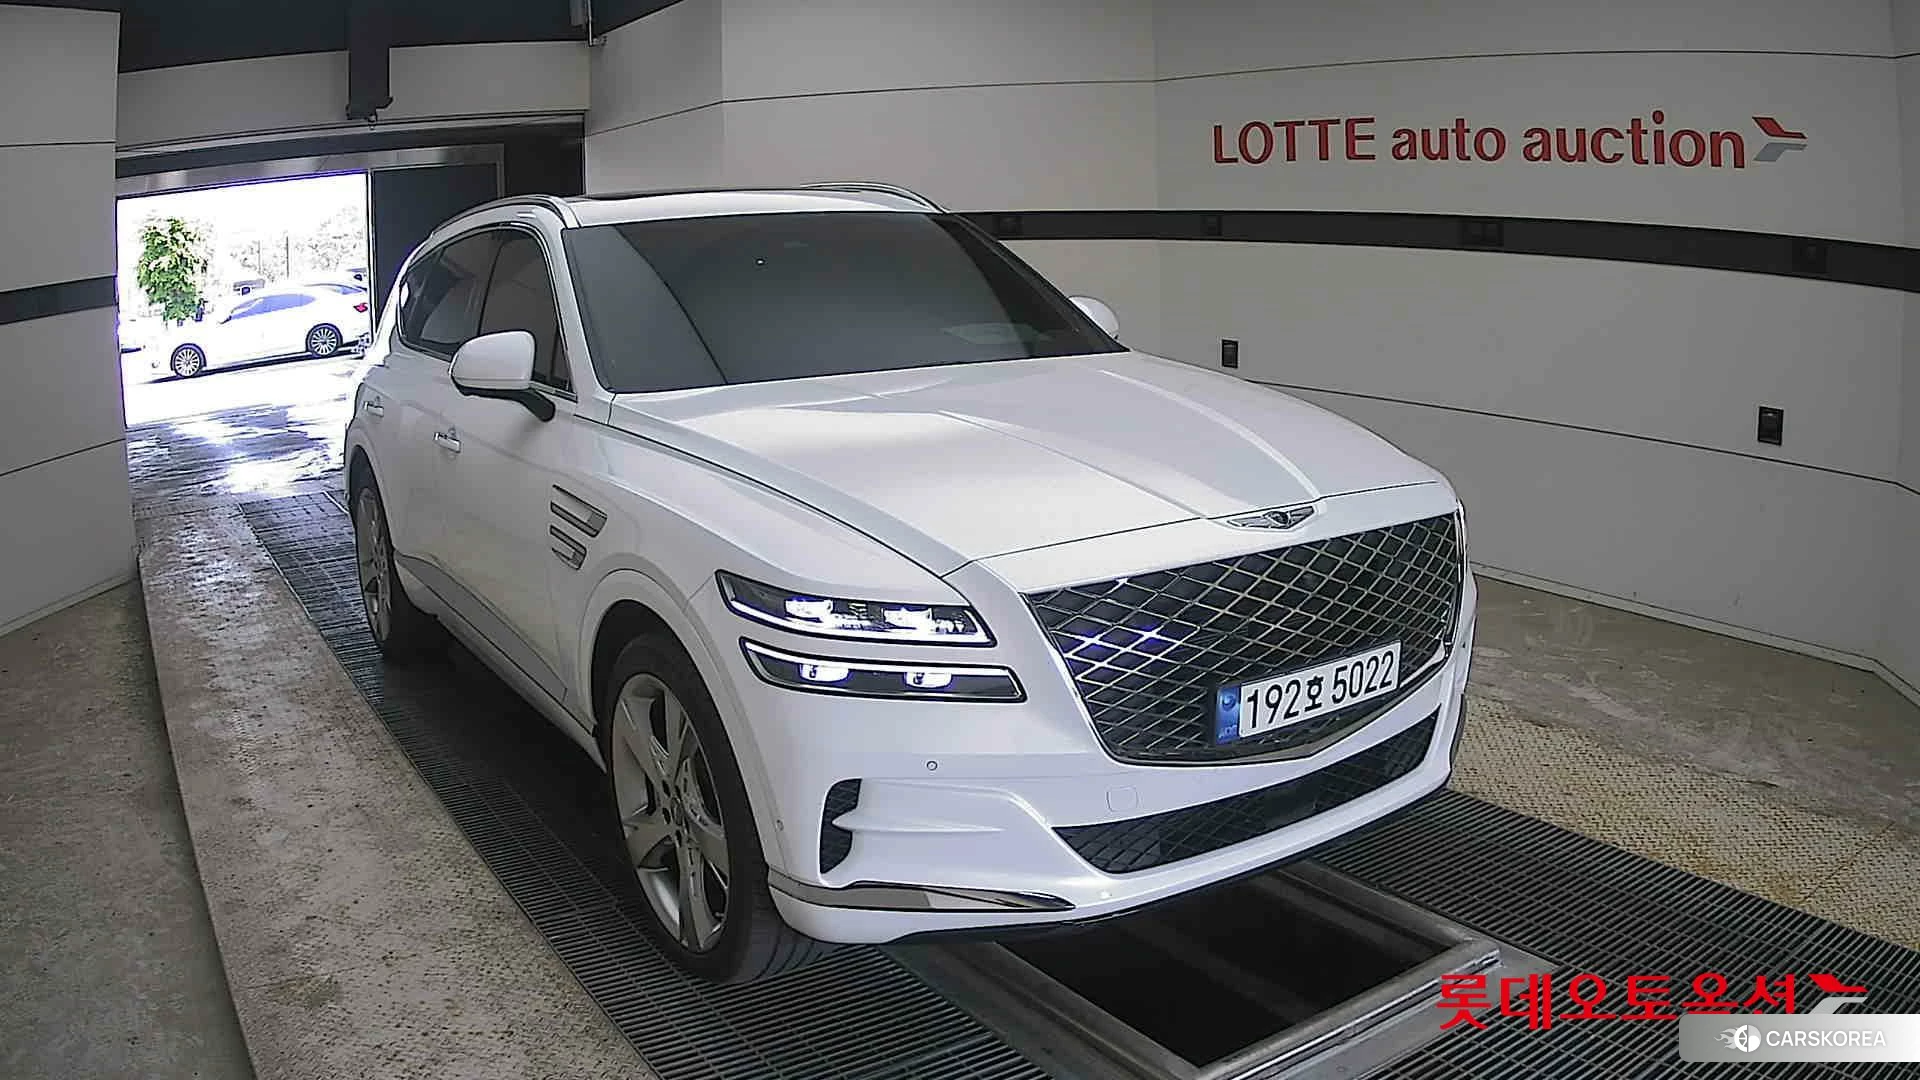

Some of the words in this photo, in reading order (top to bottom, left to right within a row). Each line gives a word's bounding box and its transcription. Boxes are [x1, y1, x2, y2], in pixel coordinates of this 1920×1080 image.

[1213, 118, 1376, 164] LOTTE
[1392, 118, 1506, 162] auto
[1522, 110, 1746, 168] auction
[1247, 675, 1325, 729] 192호
[1331, 650, 1394, 704] 5022
